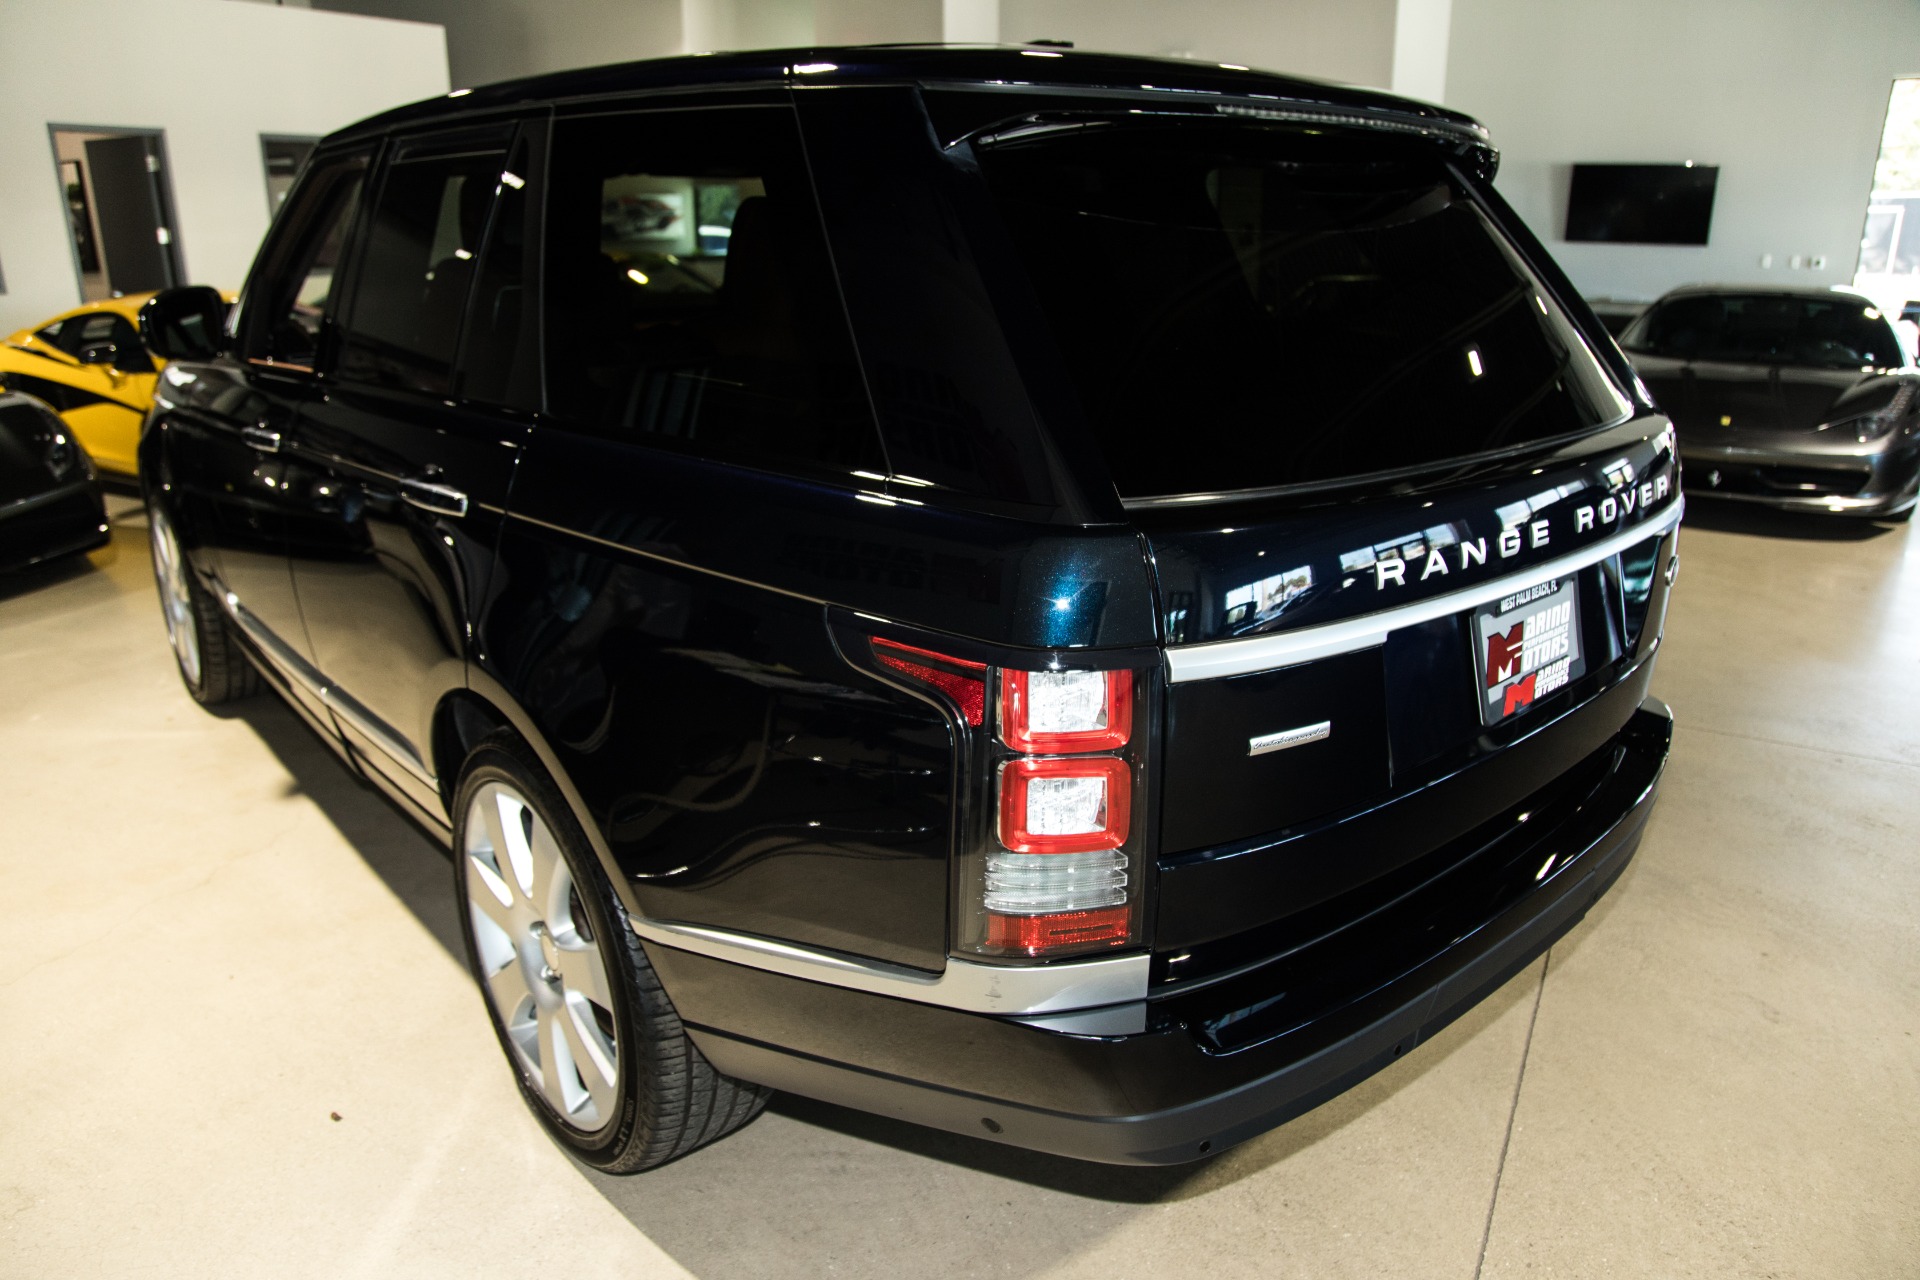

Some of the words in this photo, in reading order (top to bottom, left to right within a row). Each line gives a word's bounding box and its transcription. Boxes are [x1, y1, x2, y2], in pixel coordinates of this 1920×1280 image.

[1375, 520, 1550, 590] RANGE
[1575, 475, 1669, 534] ROVER
[1500, 595, 1516, 613] WEST
[1516, 589, 1532, 607] PALM
[1551, 579, 1558, 593] FL
